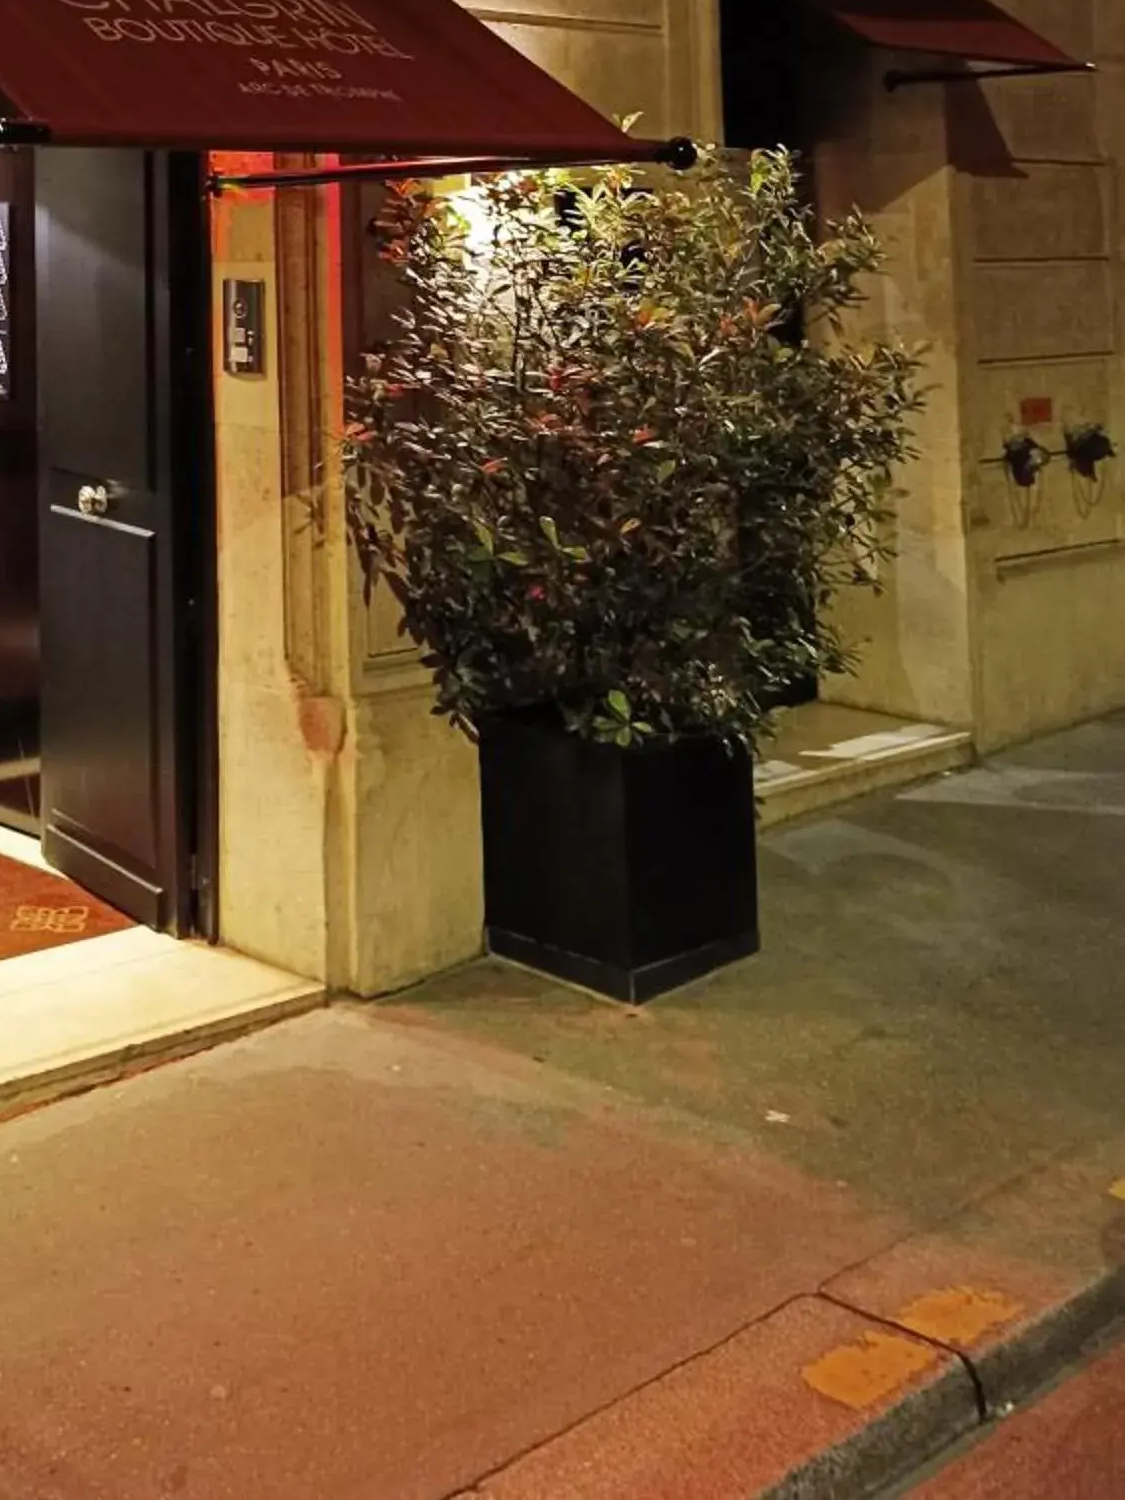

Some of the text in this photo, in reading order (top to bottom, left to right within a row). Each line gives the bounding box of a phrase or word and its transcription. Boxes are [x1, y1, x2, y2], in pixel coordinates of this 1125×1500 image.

[83, 16, 415, 61] BOUTIQUE HÔTEL
[250, 57, 343, 79] PARIS
